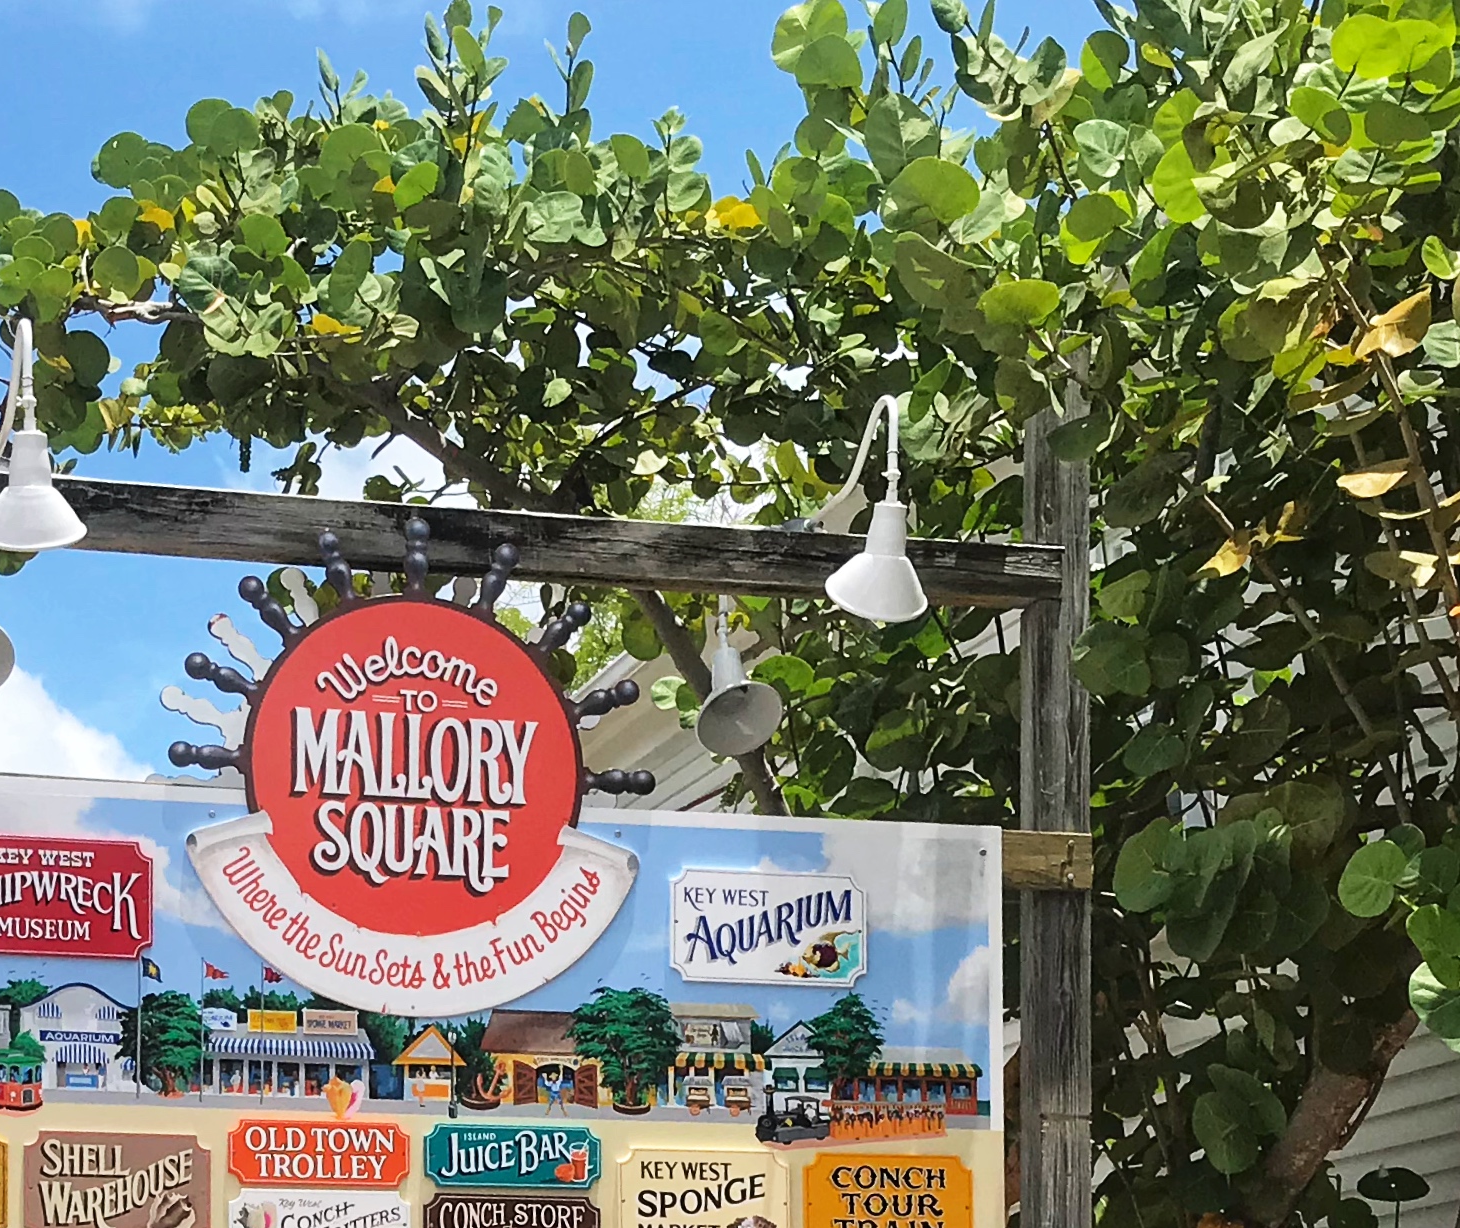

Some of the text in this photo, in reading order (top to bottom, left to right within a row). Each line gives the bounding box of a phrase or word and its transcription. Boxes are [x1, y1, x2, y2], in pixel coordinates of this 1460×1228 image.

[316, 635, 500, 708] Welcome
[400, 689, 438, 713] TO
[292, 706, 539, 806] MALLORY
[37, 850, 95, 869] WEST
[312, 799, 511, 893] SQUARE
[683, 885, 769, 911] KEY WEST
[222, 846, 602, 990] Where the Sun Sets & the Fun Begins
[683, 888, 853, 965] AQUARIUM
[44, 1032, 116, 1045] AQUARIUM
[245, 1126, 396, 1155] OLD TOWN
[463, 1131, 497, 1142] ISLAND
[40, 1137, 131, 1178] SHELL
[254, 1152, 388, 1181] TROLLEY
[440, 1128, 571, 1178] JUICE BAR
[640, 1160, 732, 1182] KEY WEST
[829, 1164, 947, 1192] CONCH
[637, 1171, 766, 1219] SPONGE
[840, 1192, 945, 1219] TOUR
